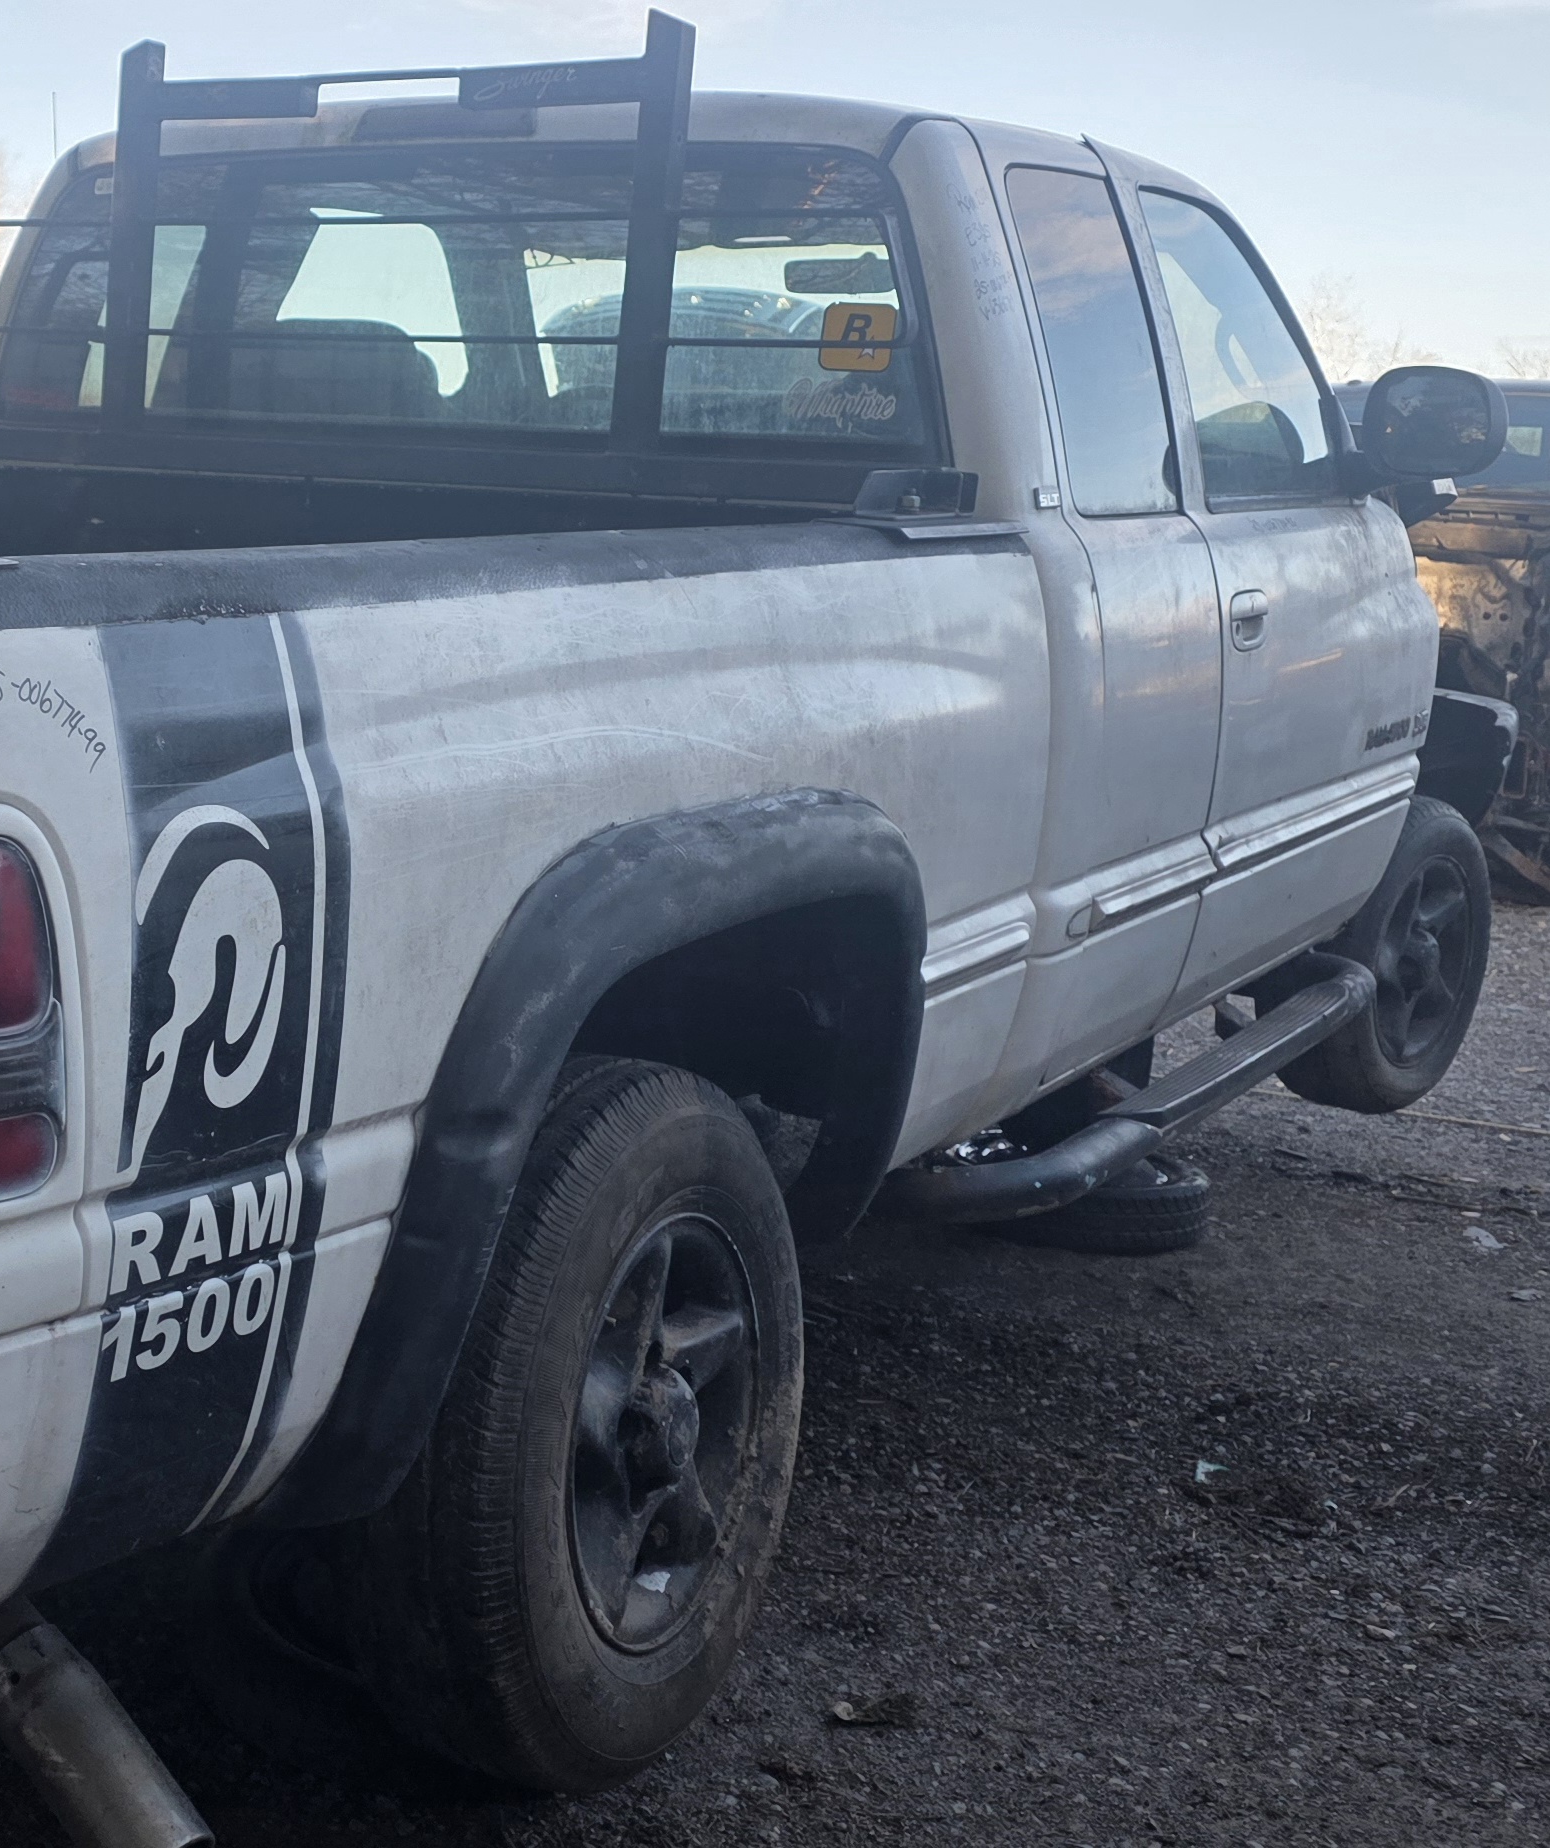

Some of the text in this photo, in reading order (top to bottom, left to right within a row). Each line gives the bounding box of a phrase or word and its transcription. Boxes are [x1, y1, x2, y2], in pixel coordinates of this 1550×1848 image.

[841, 313, 872, 343] R
[1039, 493, 1061, 507] SLT
[109, 1171, 288, 1296] RAM
[101, 1263, 275, 1383] 1500
